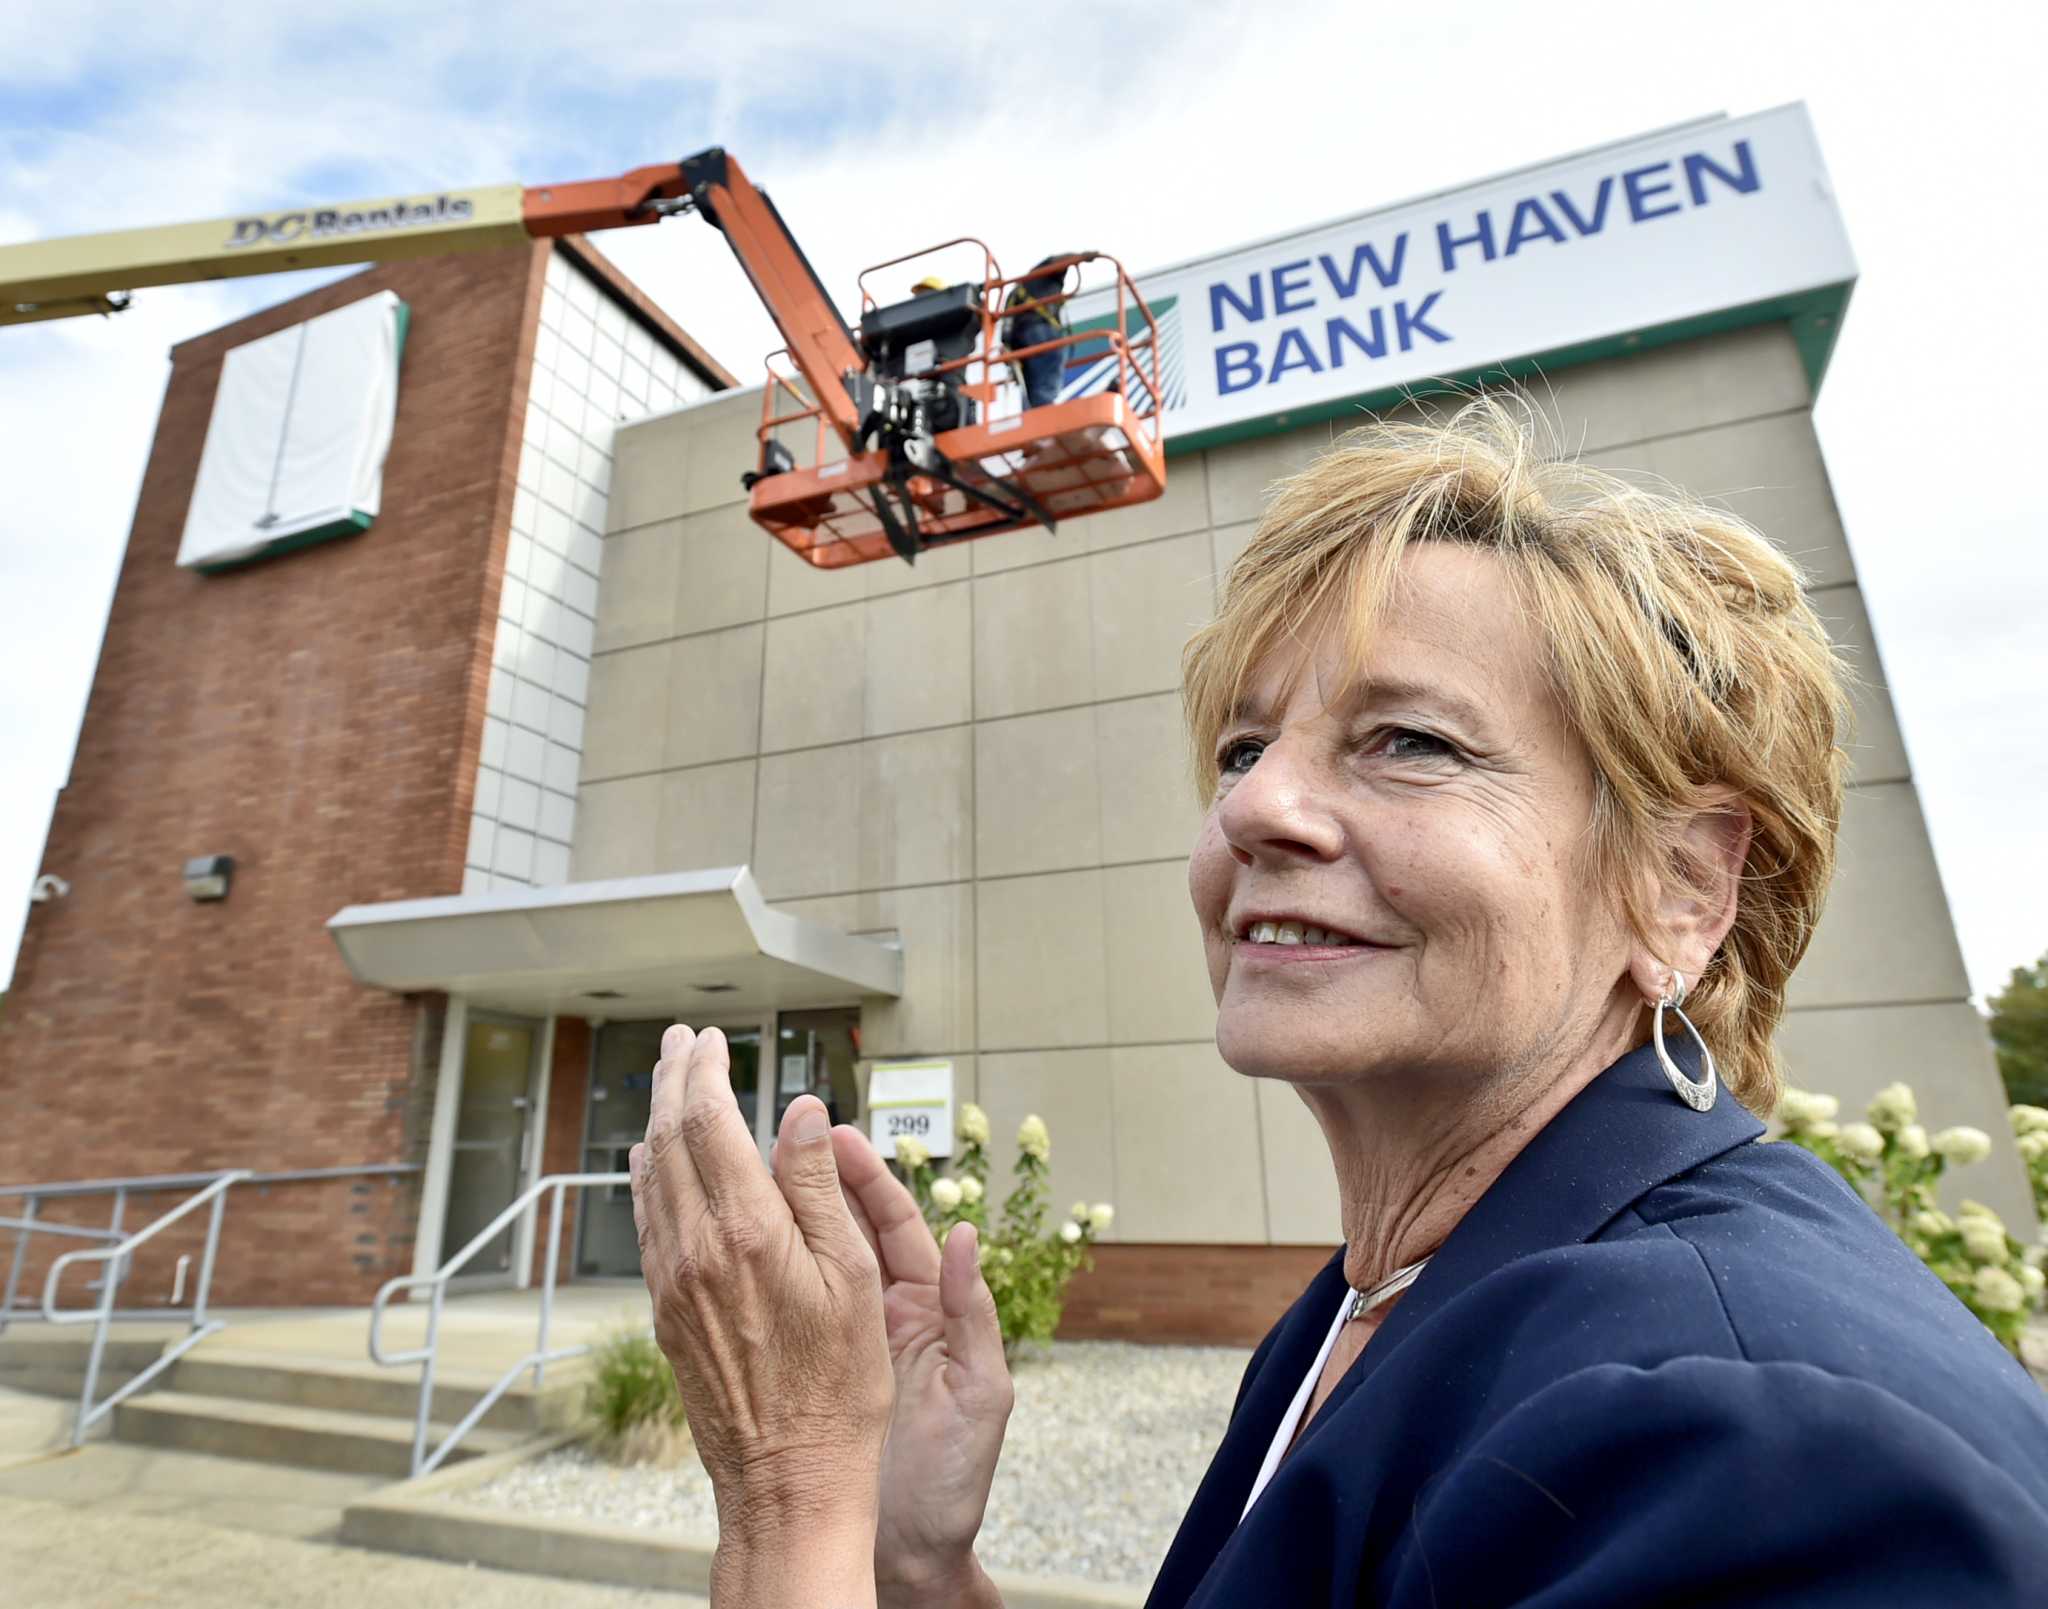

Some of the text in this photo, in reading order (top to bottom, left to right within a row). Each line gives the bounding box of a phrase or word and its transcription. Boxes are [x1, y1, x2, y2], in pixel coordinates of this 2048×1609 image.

[224, 195, 473, 247] DC Rentals
[1208, 139, 1762, 333] NEW HAVEN
[1213, 291, 1453, 397] BANK
[888, 1114, 930, 1136] 299
